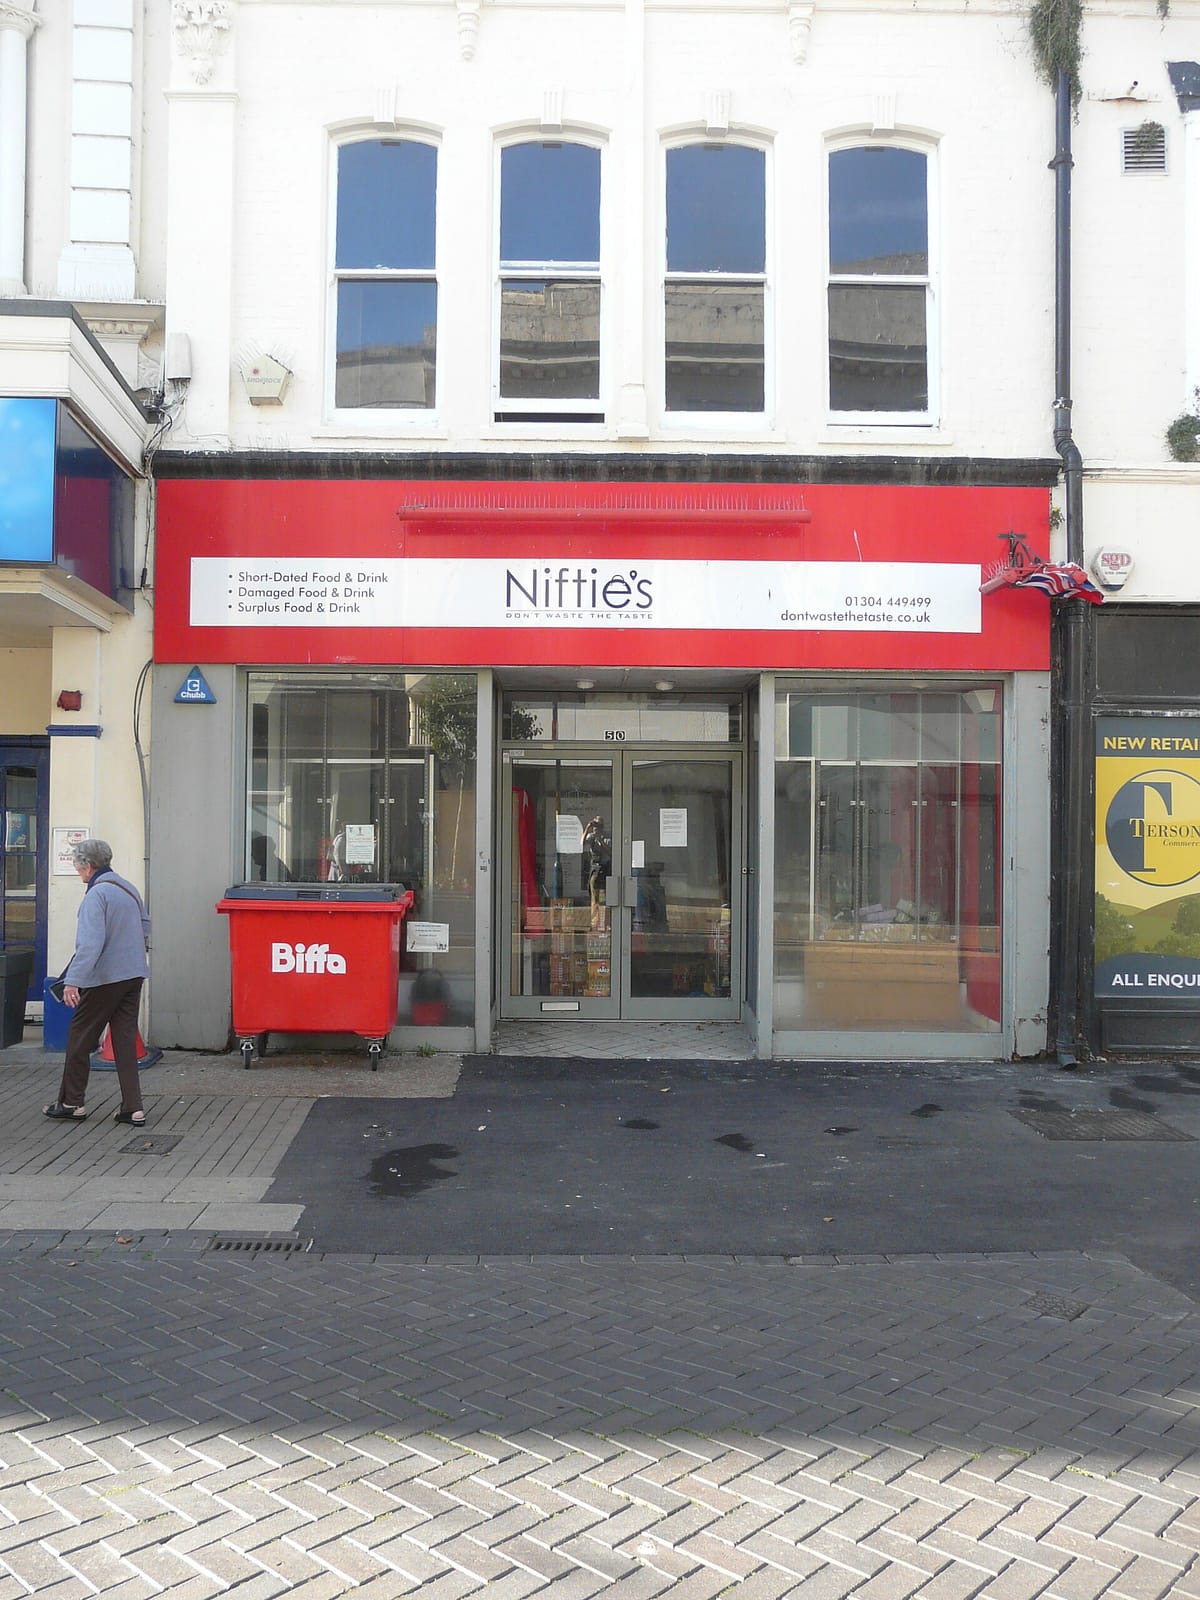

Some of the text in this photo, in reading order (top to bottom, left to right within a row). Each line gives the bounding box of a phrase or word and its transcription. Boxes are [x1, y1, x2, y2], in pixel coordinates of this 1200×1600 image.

[238, 571, 389, 583] Short-Dated Food & Drink
[238, 587, 375, 599] Damaged Food & Drink
[506, 567, 654, 609] Niftie's
[238, 602, 361, 614] Surplus Food & Drink
[845, 596, 932, 608] 01304 449499
[780, 610, 931, 623] dontwastethetaste.co.uk
[605, 731, 625, 740] 50
[1103, 737, 1147, 750] NEW
[271, 942, 347, 974] Biffa
[1111, 973, 1144, 986] ALL
